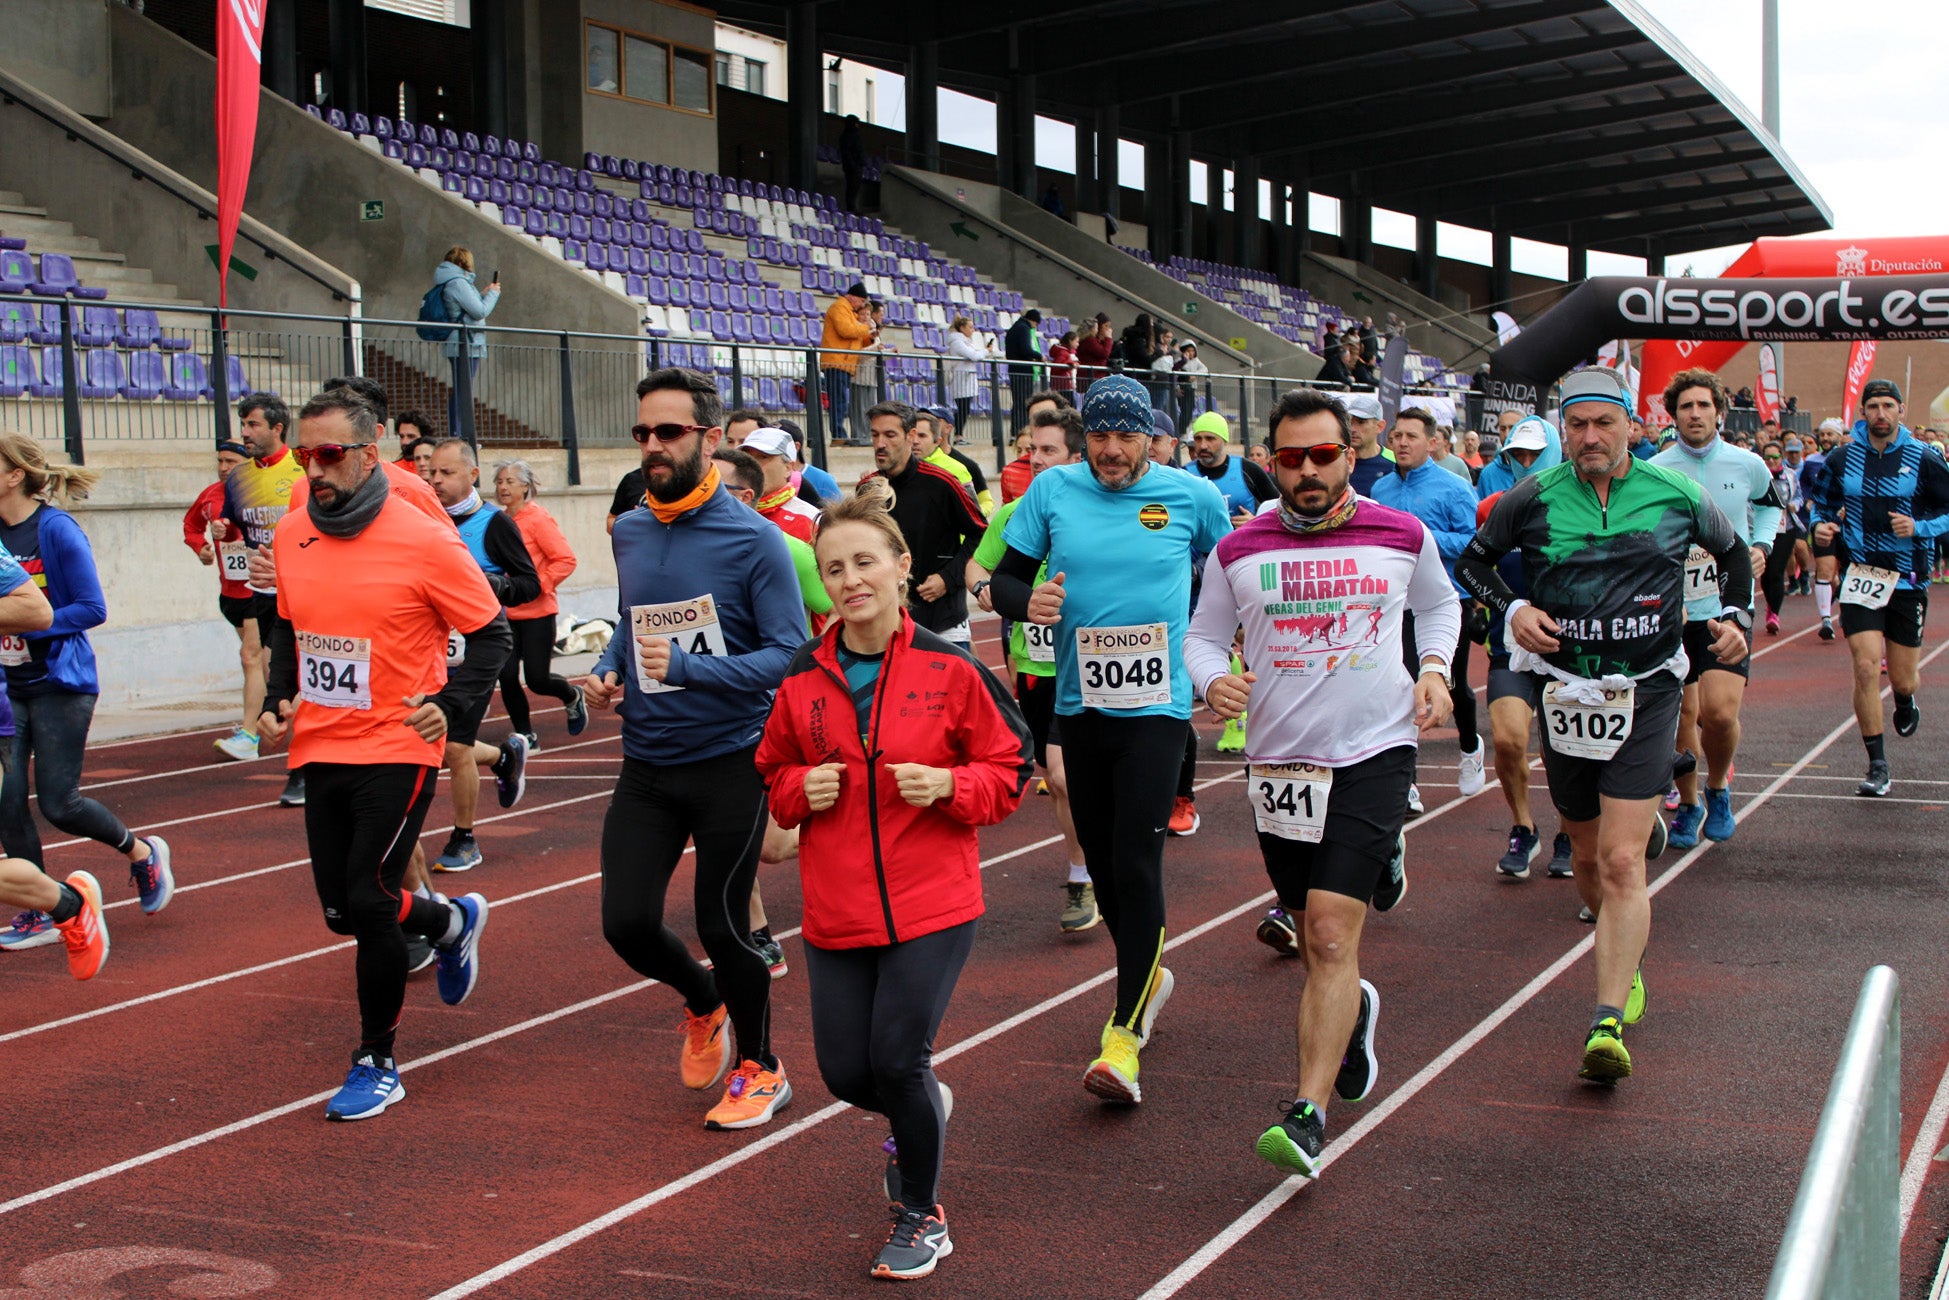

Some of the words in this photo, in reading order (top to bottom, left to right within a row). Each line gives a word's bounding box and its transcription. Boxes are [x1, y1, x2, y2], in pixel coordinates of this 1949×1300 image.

[1870, 258, 1942, 272] Diputación
[1617, 279, 1949, 340] alssport.es
[1753, 331, 1820, 340] RUNNING
[1832, 331, 1874, 340] TRAIL
[1886, 330, 1949, 339] OUTDOO
[1260, 562, 1277, 591] III
[1281, 558, 1358, 581] MEDIA
[1281, 575, 1388, 602] MARATÓN
[1848, 578, 1885, 599] 302
[646, 608, 697, 627] FONDO
[1264, 603, 1294, 615] VEGAS
[1296, 603, 1313, 614] DEL
[1316, 601, 1343, 614] GENIL
[1611, 614, 1661, 640] CARA
[306, 635, 354, 653] FONDO
[1096, 632, 1152, 648] FONDO
[307, 657, 359, 694] 394
[1085, 657, 1163, 689] 3048
[1280, 660, 1305, 668] SPAR
[1551, 709, 1626, 741] 3102
[1259, 781, 1313, 818] 341
